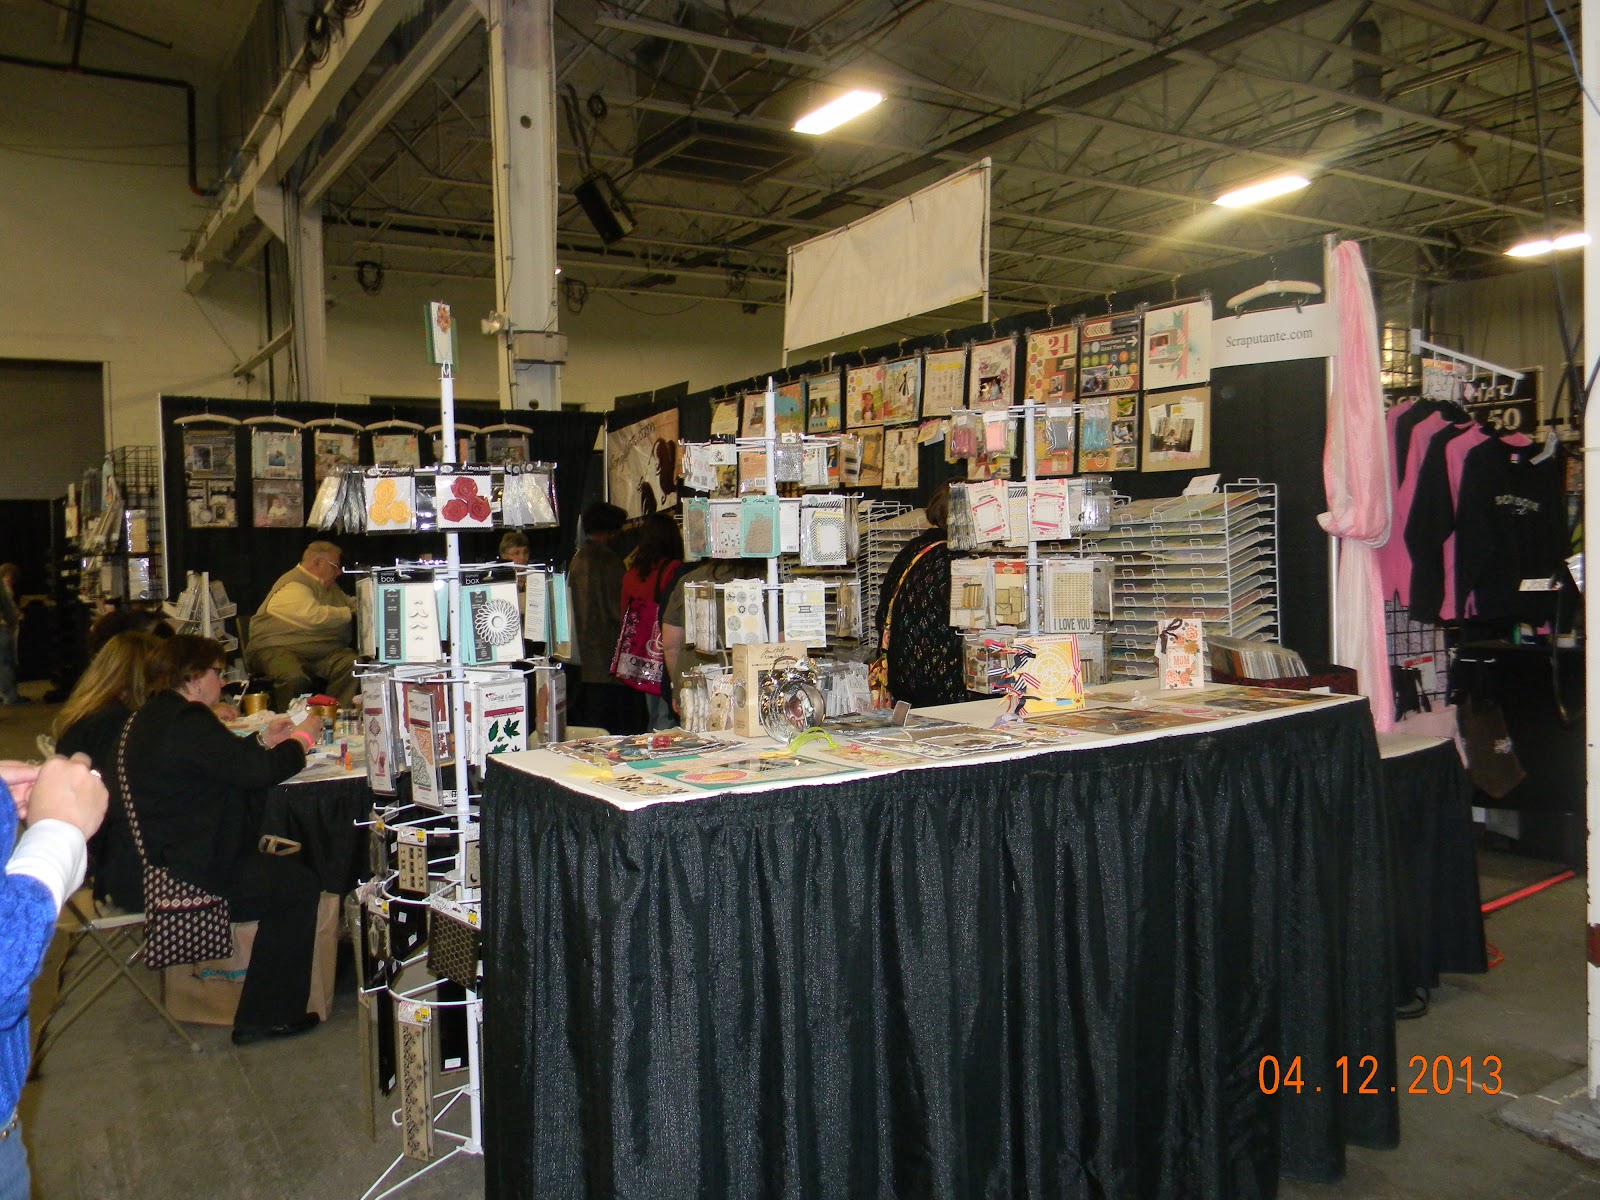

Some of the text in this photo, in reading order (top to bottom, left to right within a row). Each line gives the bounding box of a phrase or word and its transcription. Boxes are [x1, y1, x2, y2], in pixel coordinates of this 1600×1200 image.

[1048, 335, 1069, 354] 24
[1226, 328, 1312, 348] Scraputante.com
[1054, 617, 1091, 630] I LOVE YOU
[1173, 655, 1190, 665] MOM
